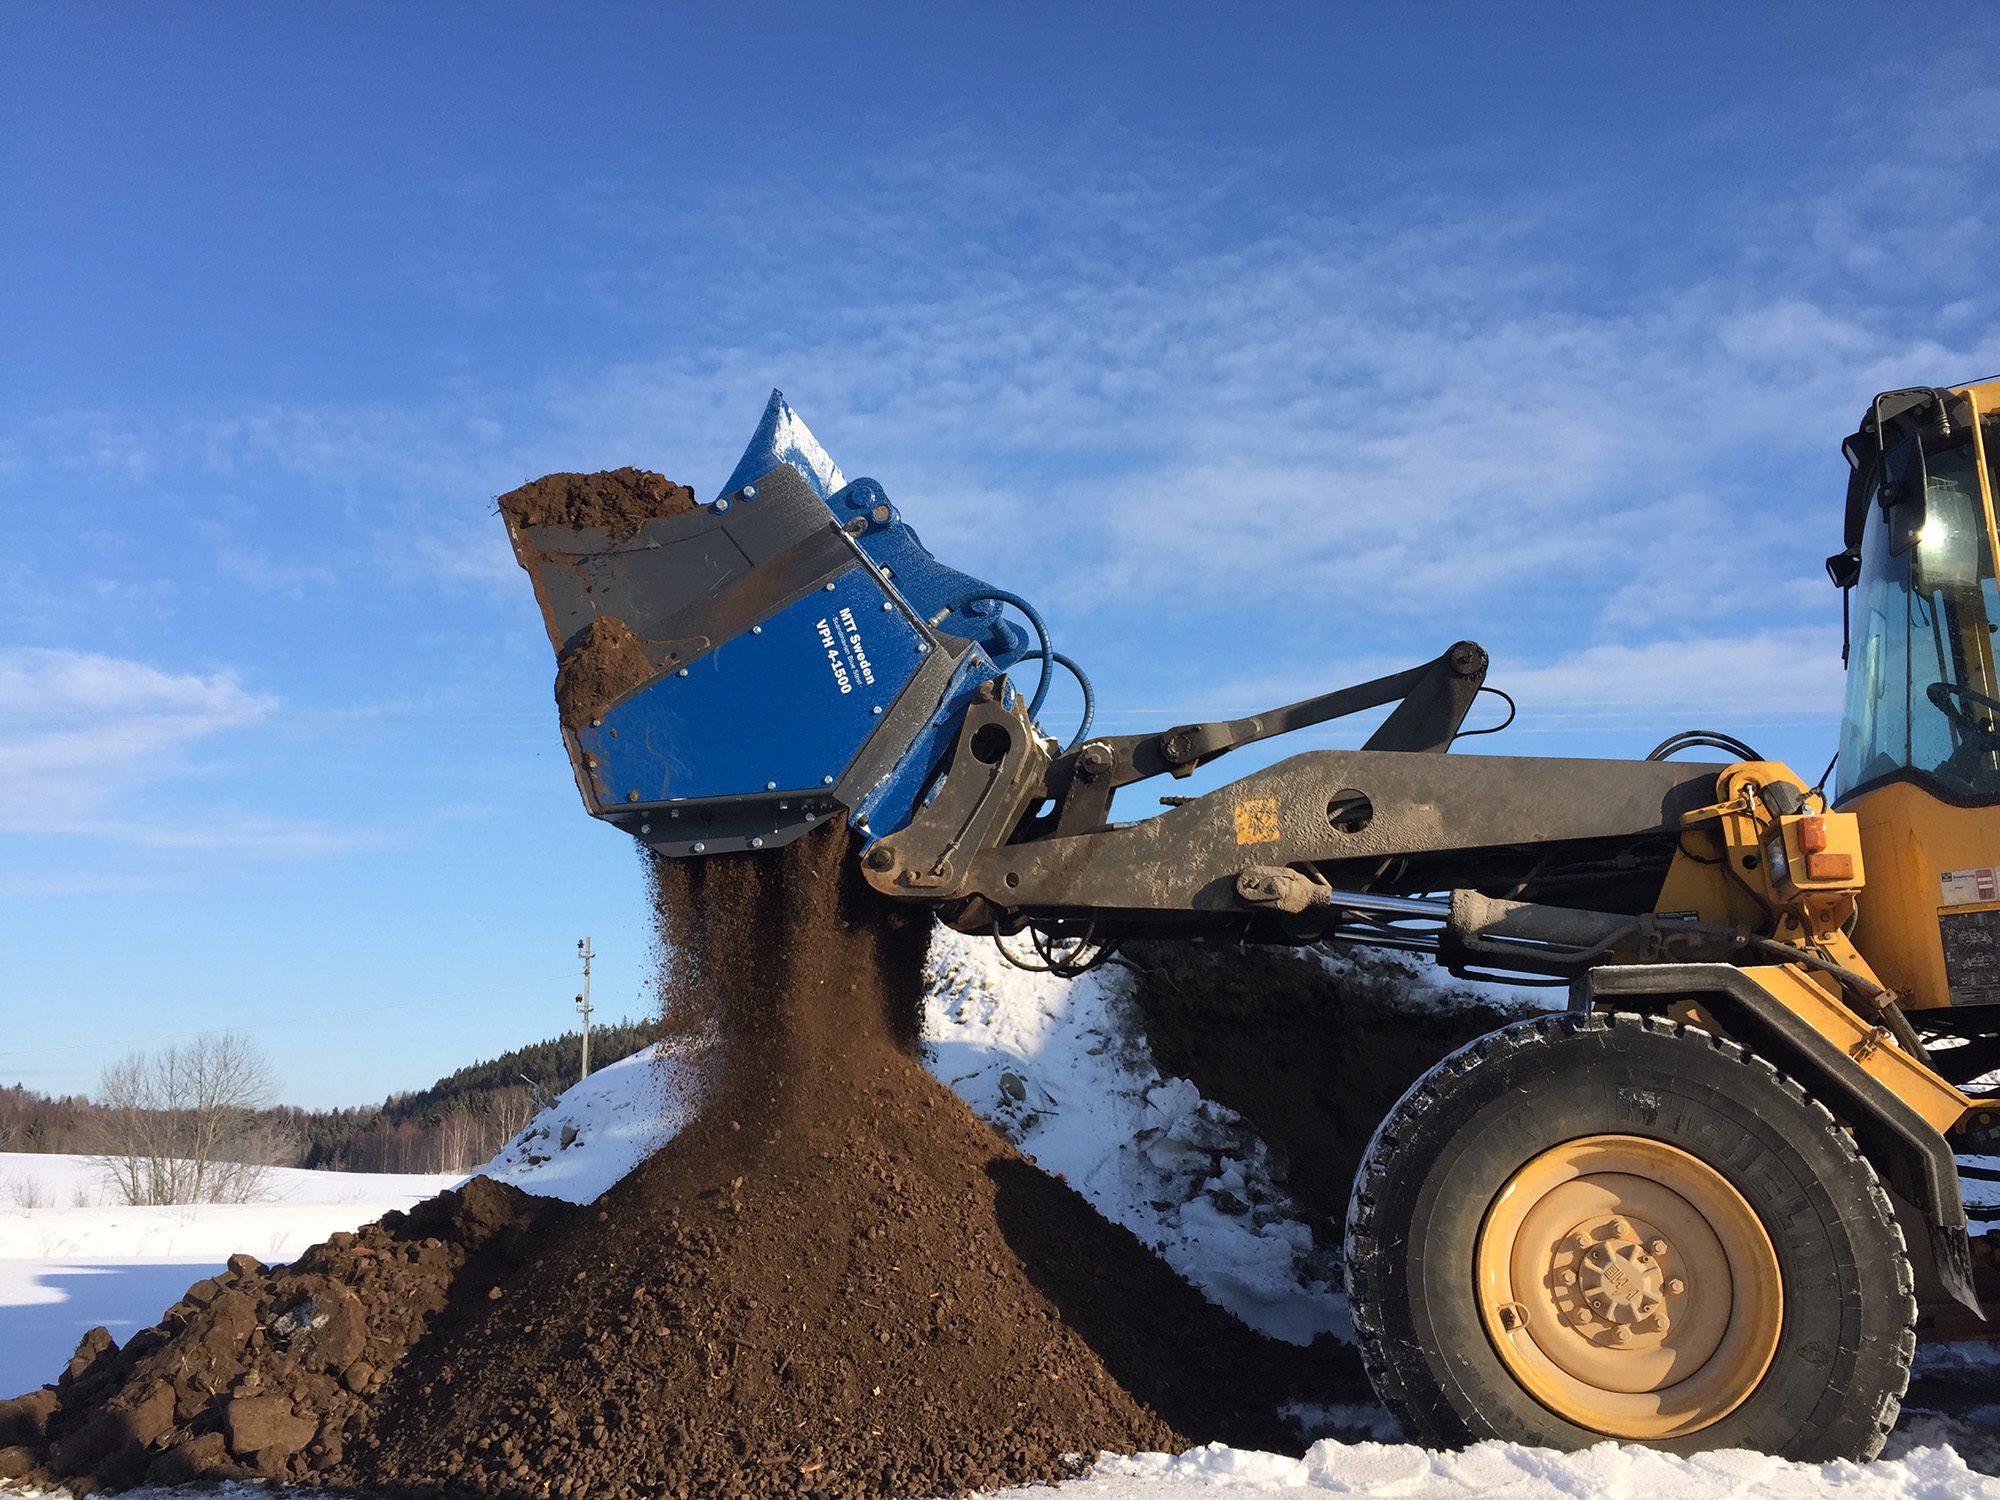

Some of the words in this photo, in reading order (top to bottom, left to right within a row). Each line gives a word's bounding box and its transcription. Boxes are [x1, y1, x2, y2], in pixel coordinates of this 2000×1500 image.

[816, 618, 835, 648] VPH
[828, 649, 852, 694] 4-1500
[839, 607, 857, 632] MTT
[849, 634, 875, 685] Sweden
[847, 655, 856, 669] Blue
